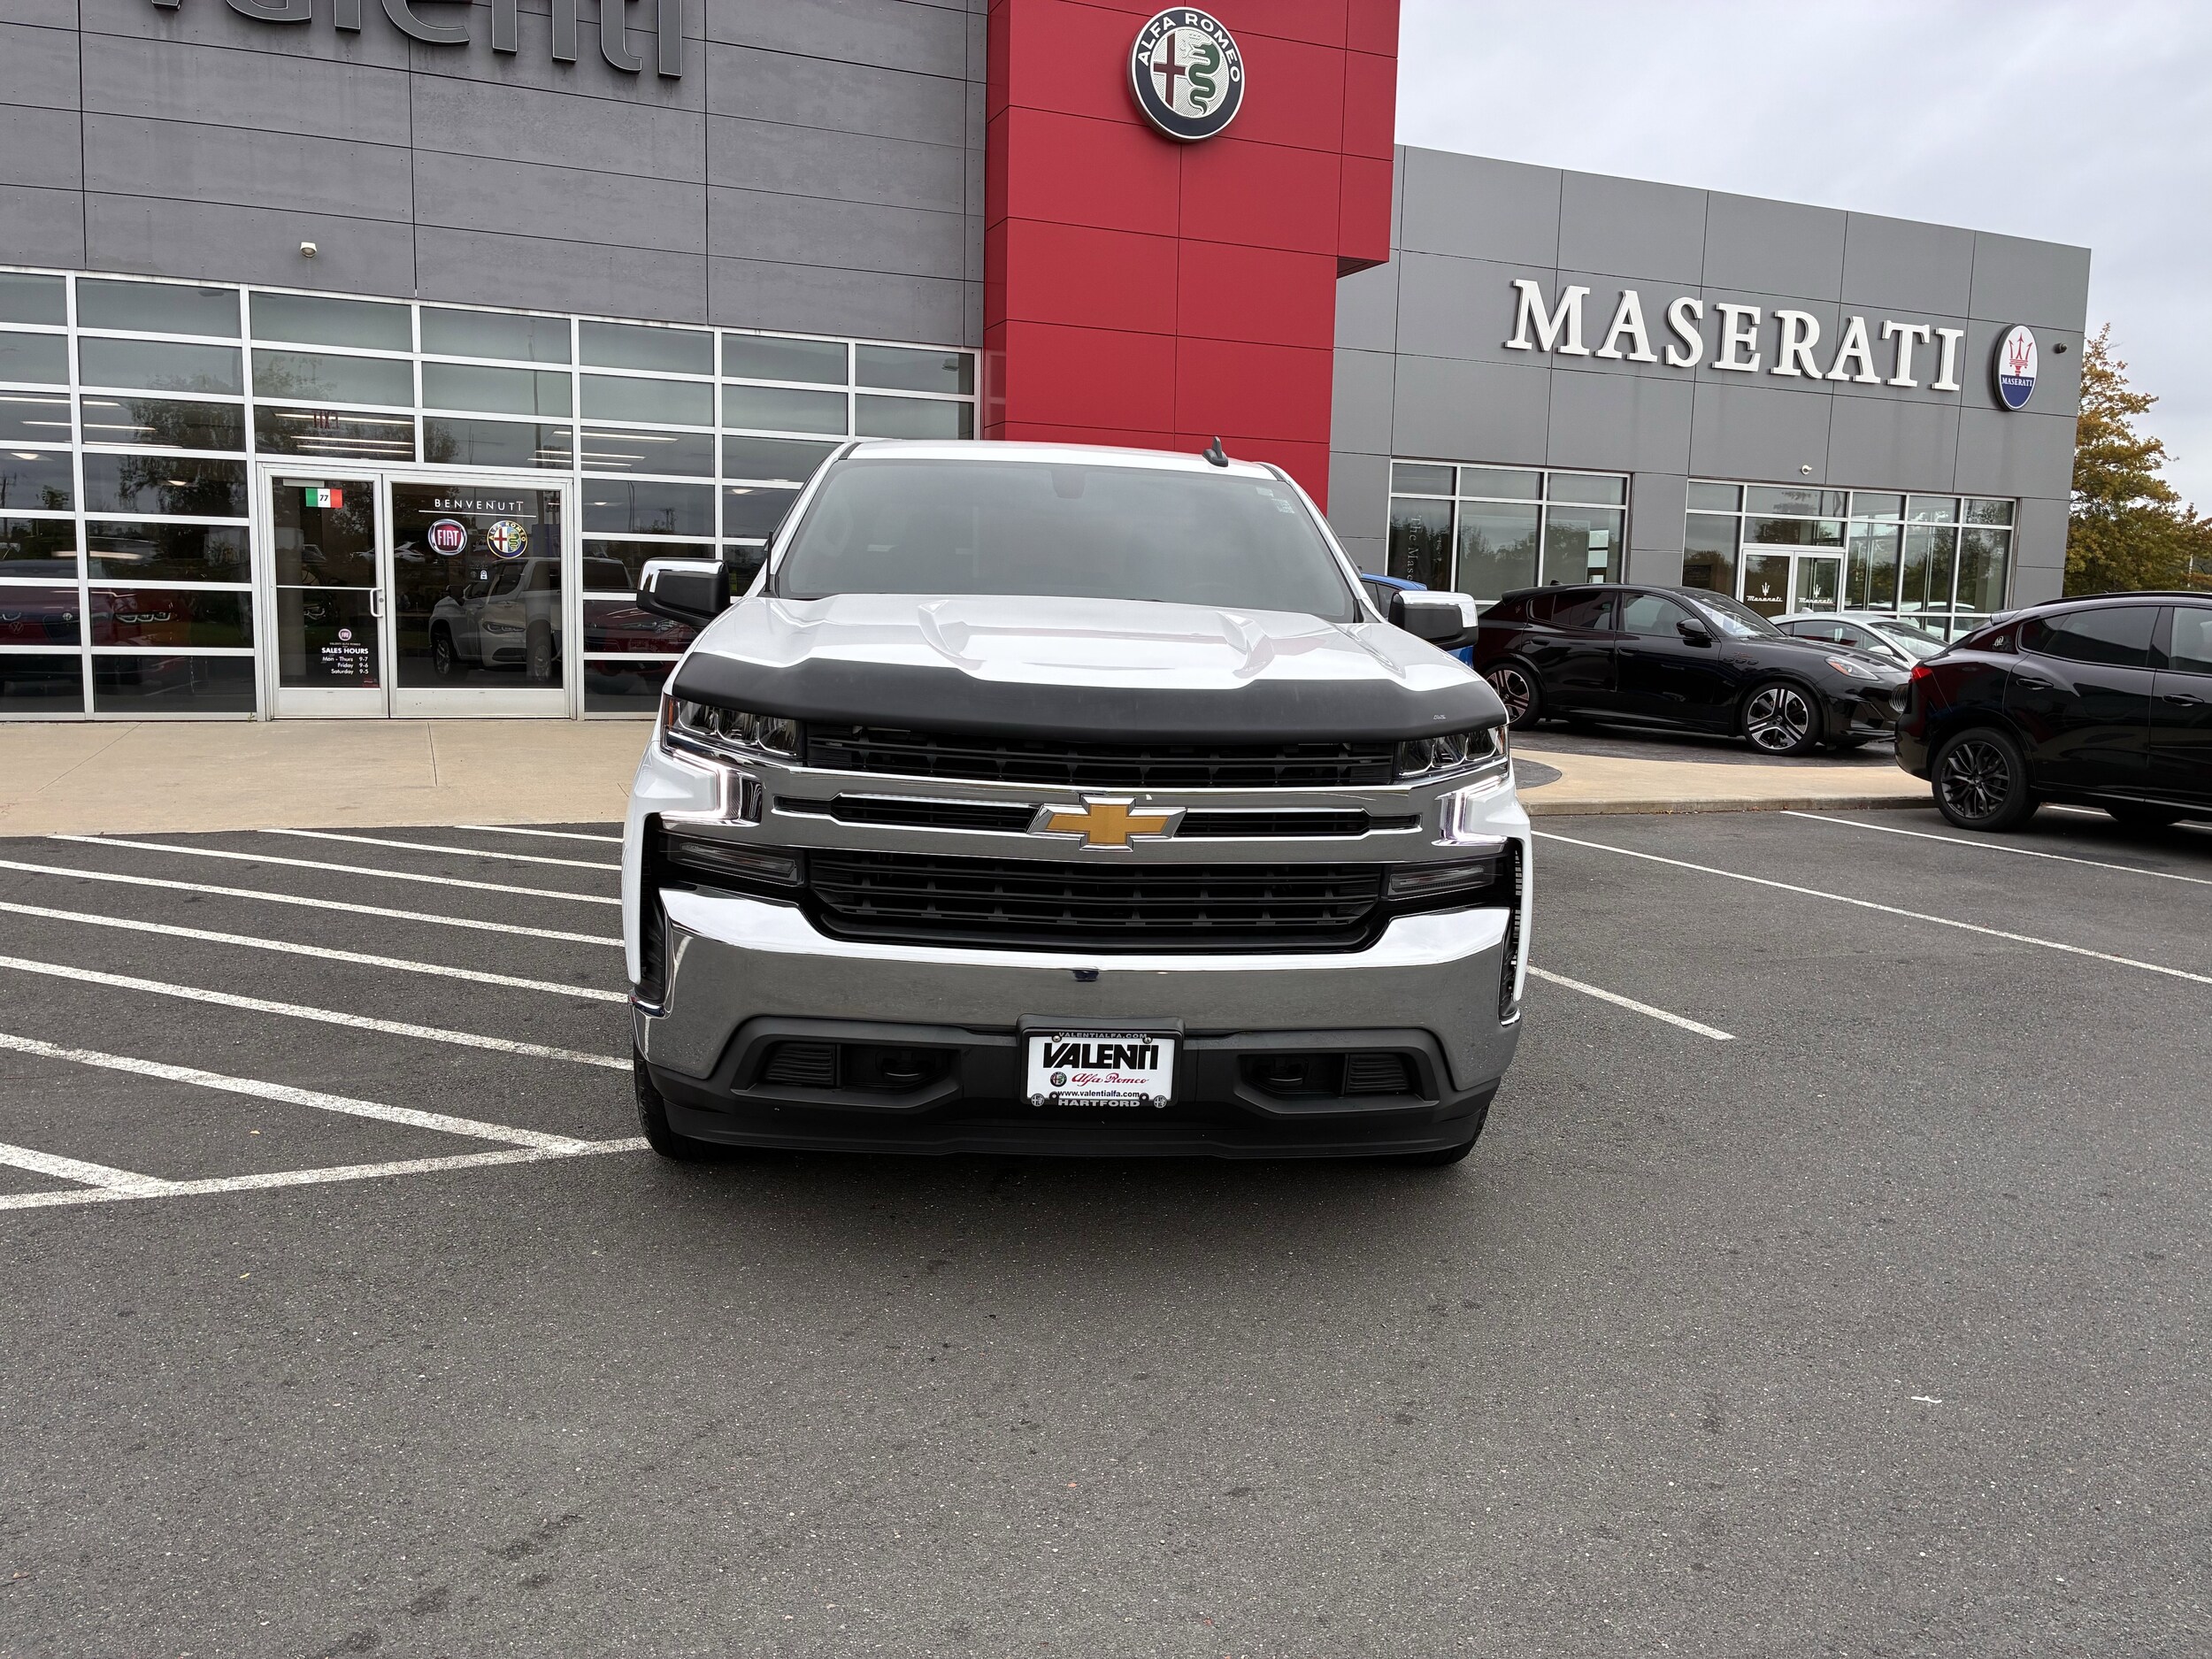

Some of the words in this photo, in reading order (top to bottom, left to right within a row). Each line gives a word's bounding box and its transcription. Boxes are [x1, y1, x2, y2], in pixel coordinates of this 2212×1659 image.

[1137, 16, 1176, 67] ALFA
[1185, 12, 1240, 82] ROMEO
[1503, 278, 1964, 391] MASERATI
[2001, 377, 2033, 387] MASERATI
[437, 529, 459, 546] FIAT
[488, 523, 503, 541] ALFA
[505, 521, 526, 542] ROMEO
[1042, 1042, 1159, 1070] VALENTI
[1071, 1072, 1103, 1087] Alfa
[1104, 1072, 1149, 1084] Romeo
